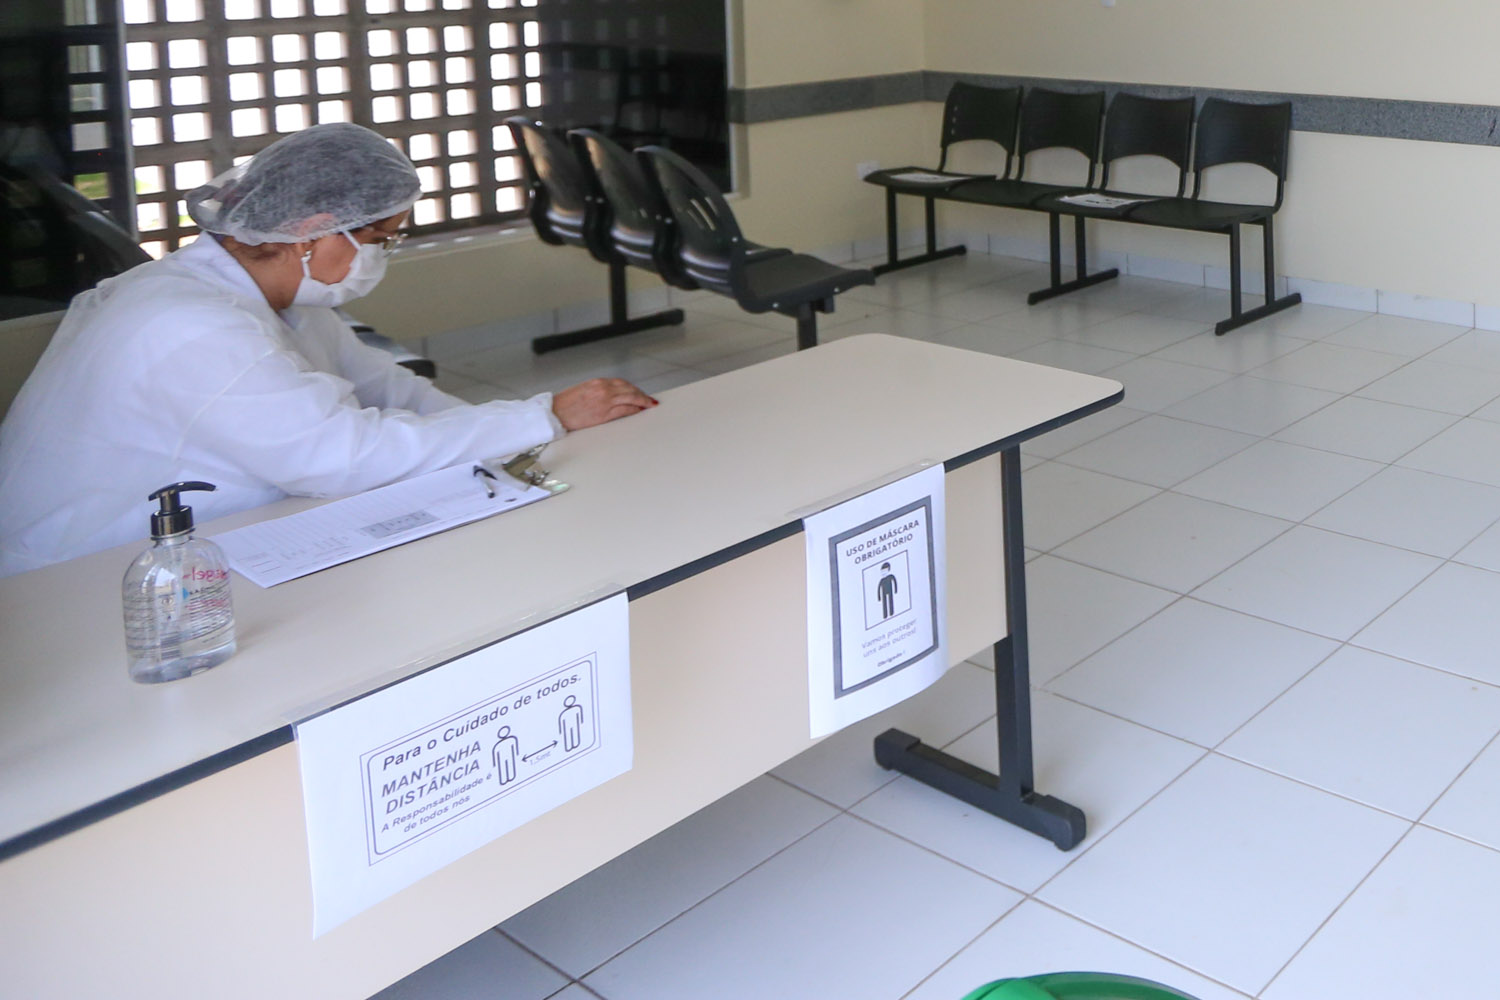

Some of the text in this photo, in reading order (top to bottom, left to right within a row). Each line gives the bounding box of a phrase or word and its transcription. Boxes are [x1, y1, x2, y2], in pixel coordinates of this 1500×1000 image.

[846, 520, 919, 556] USO DE MÁSCARA
[854, 533, 913, 564] OBRIGATÓRIO
[383, 674, 582, 771] Para o Cuidado de todos.
[382, 740, 481, 798] MANTENHA
[386, 759, 480, 814] DISTÂNCIA
[381, 822, 389, 832] A
[392, 777, 484, 828] Responsabilidade
[404, 794, 470, 832] de todos nós
